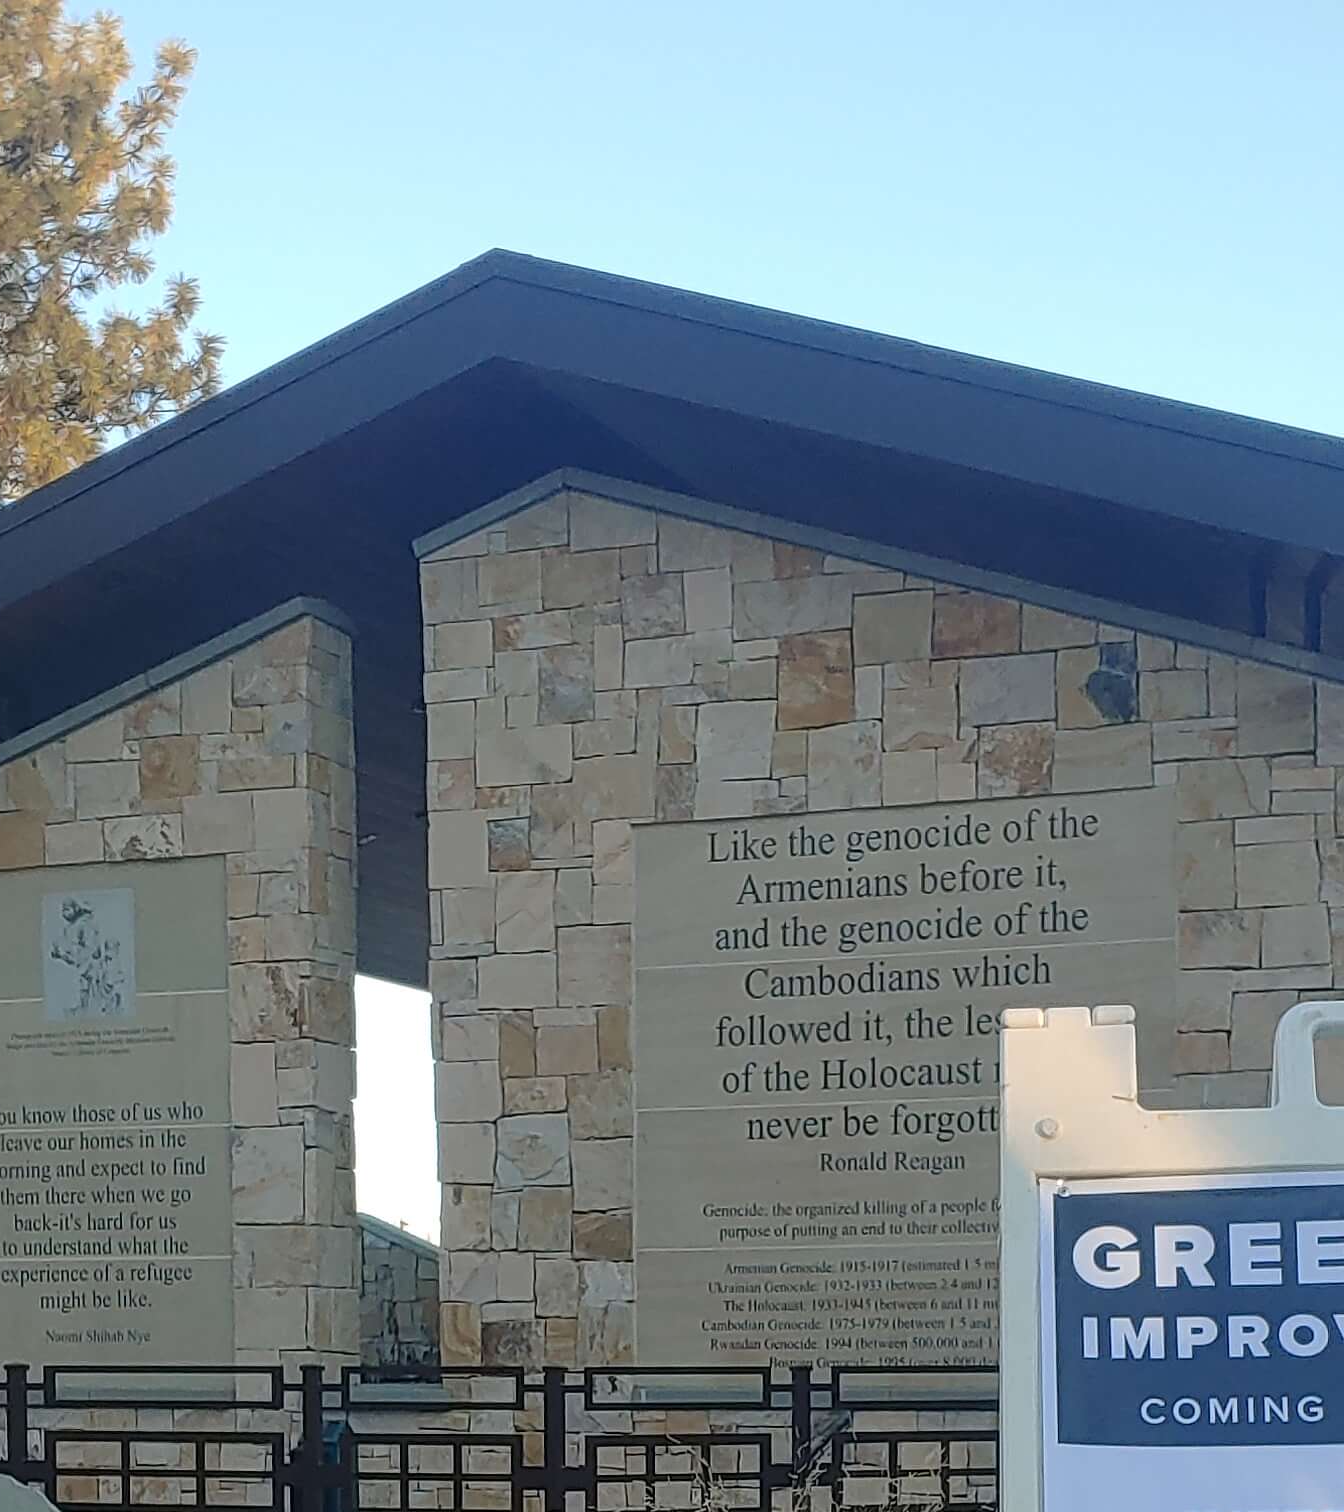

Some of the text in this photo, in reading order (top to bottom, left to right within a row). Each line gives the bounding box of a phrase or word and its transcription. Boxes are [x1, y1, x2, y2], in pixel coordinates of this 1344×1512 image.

[708, 808, 1098, 863] Like the genocide of the
[736, 856, 1066, 905] Armenians before it,
[715, 901, 1088, 952] and the genocide of the
[745, 954, 1050, 999] Cambodians which
[715, 1013, 851, 1047] followed
[863, 1010, 891, 1045] it,
[906, 1007, 954, 1039] the
[722, 1063, 759, 1094] of
[764, 1061, 809, 1091] the
[821, 1057, 983, 1090] Holocaust
[22, 1106, 65, 1124] know
[73, 1104, 115, 1122] those
[121, 1103, 139, 1121] of
[144, 1106, 162, 1119] us
[168, 1103, 203, 1120] who
[748, 1103, 1000, 1142] never be forgott
[1, 1130, 185, 1152] leave our homes in the
[57, 1160, 85, 1177] and
[91, 1161, 144, 1183] expect
[150, 1161, 166, 1175] to
[172, 1157, 206, 1175] find
[820, 1152, 966, 1172] Ronald Reagan
[0, 1186, 191, 1207] them there when we go
[772, 1203, 792, 1216] the
[796, 1202, 859, 1219] organized
[864, 1201, 907, 1217] killing
[911, 1200, 927, 1214] of
[940, 1200, 987, 1216] people
[14, 1213, 177, 1232] back-it's hard for us
[719, 1219, 998, 1242] purpose of putting an end to their collectiv
[2, 1237, 189, 1257] to understand what the
[1, 1265, 88, 1286] experience
[94, 1263, 114, 1282] of
[130, 1263, 192, 1285] refugee
[40, 1291, 152, 1312] might be like.
[723, 1300, 745, 1312] The
[46, 1329, 81, 1343] Naomi
[128, 1329, 151, 1343] Nye
[1140, 1395, 1325, 1425] COMING
